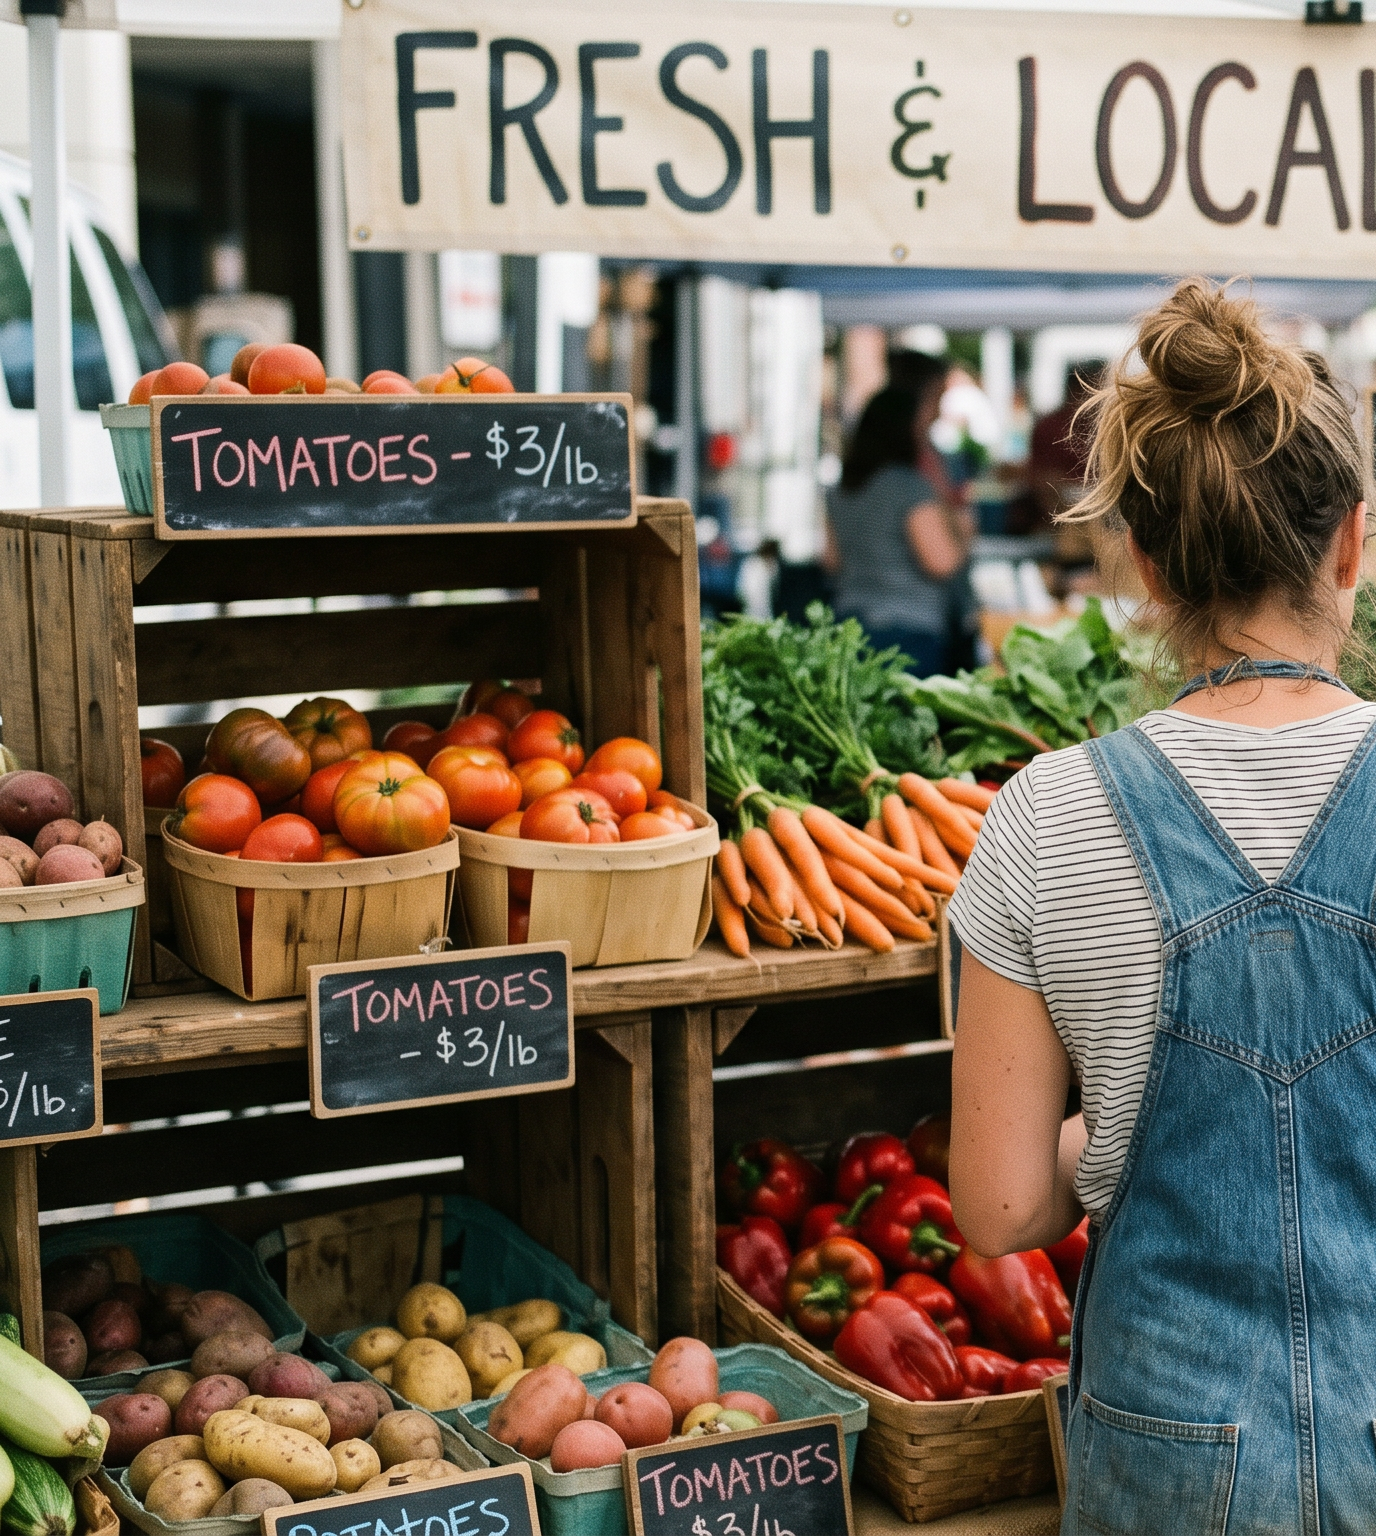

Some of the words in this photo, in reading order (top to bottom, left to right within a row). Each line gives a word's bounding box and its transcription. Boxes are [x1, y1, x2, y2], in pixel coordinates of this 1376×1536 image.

[395, 31, 831, 216] FRESH
[890, 59, 951, 210] &
[171, 427, 438, 492] TOMATOES
[485, 420, 598, 488] $3/lb
[331, 968, 553, 1033] TOMATOES
[436, 1020, 539, 1077] $3/lb
[640, 1443, 839, 1516] TOMATOES
